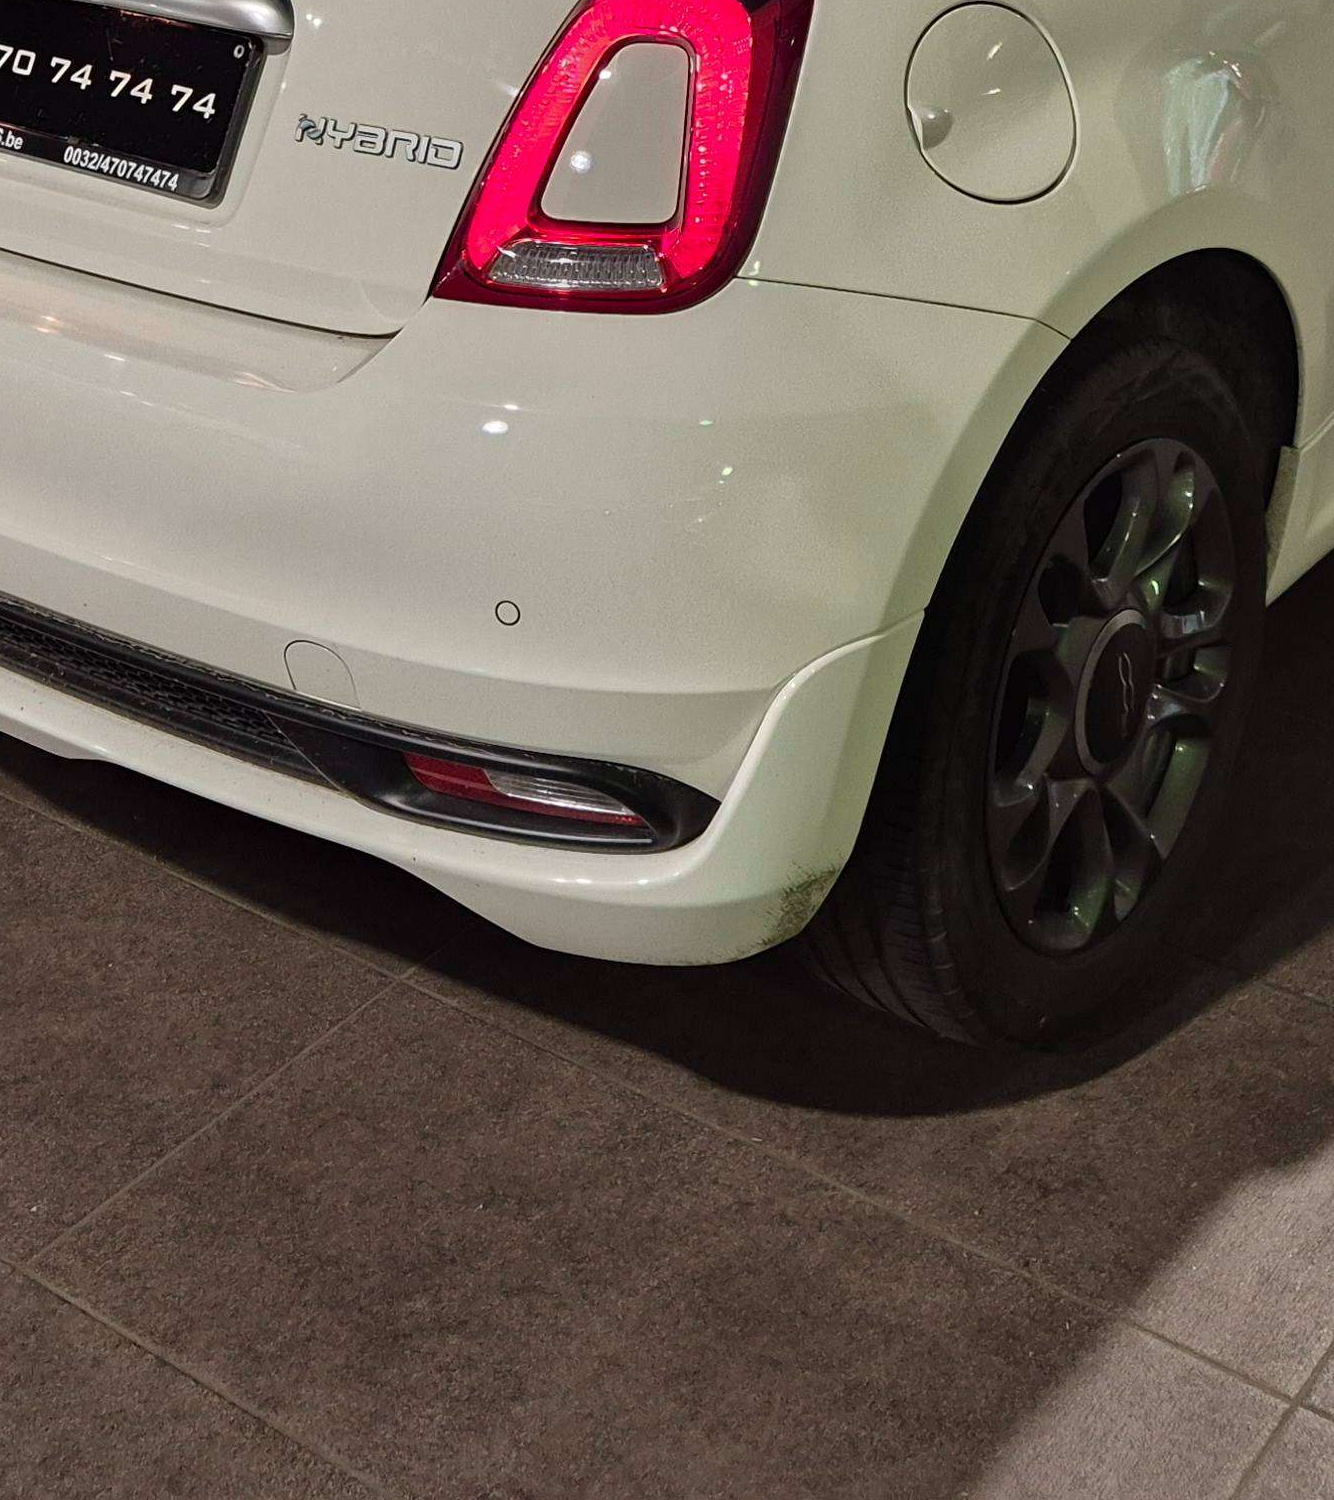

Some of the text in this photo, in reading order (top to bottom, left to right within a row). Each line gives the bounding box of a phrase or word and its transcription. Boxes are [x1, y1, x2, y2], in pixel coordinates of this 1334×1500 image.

[50, 57, 92, 91] 74
[109, 70, 153, 105] 74
[171, 84, 216, 120] 74
[63, 145, 179, 192] 0032/470747474
[295, 113, 464, 171] HYBRID
